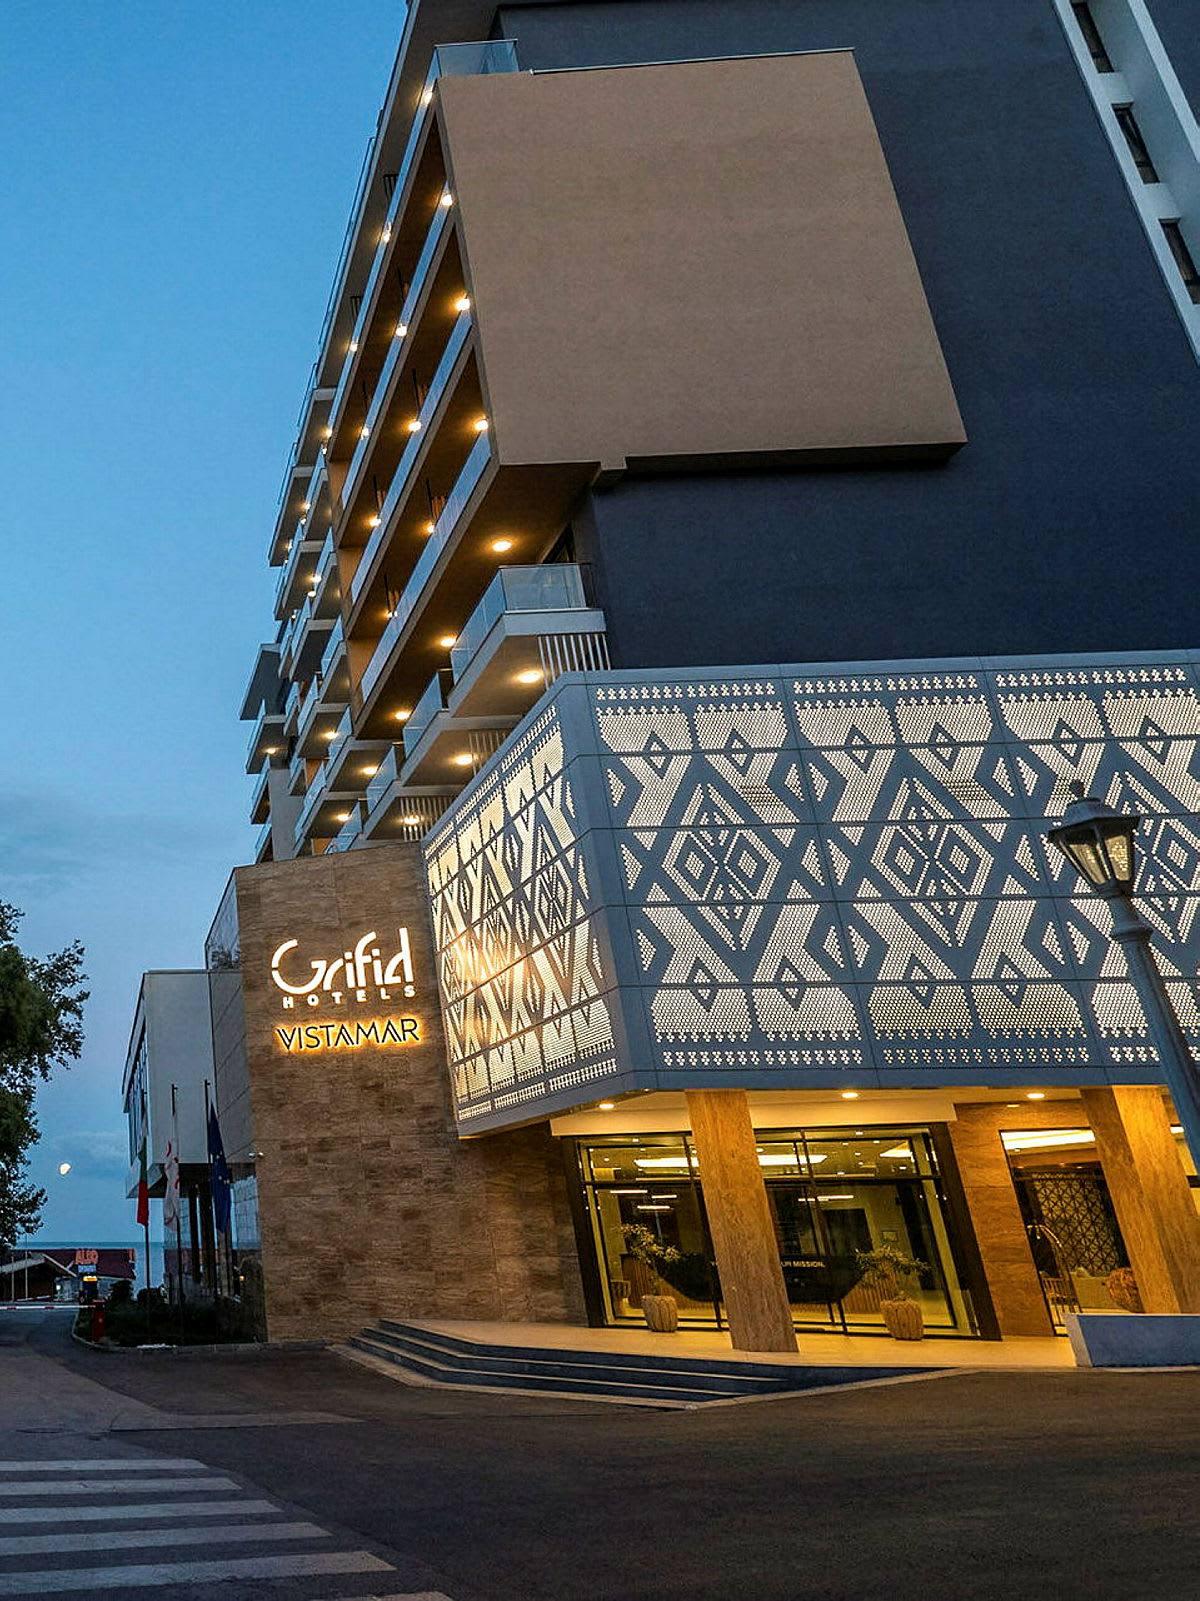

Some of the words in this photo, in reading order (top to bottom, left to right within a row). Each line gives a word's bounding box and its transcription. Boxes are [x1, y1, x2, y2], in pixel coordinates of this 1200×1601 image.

[271, 927, 414, 995] Grifid
[282, 985, 416, 1009] HOTELS
[276, 1018, 420, 1050] VISTAMAR
